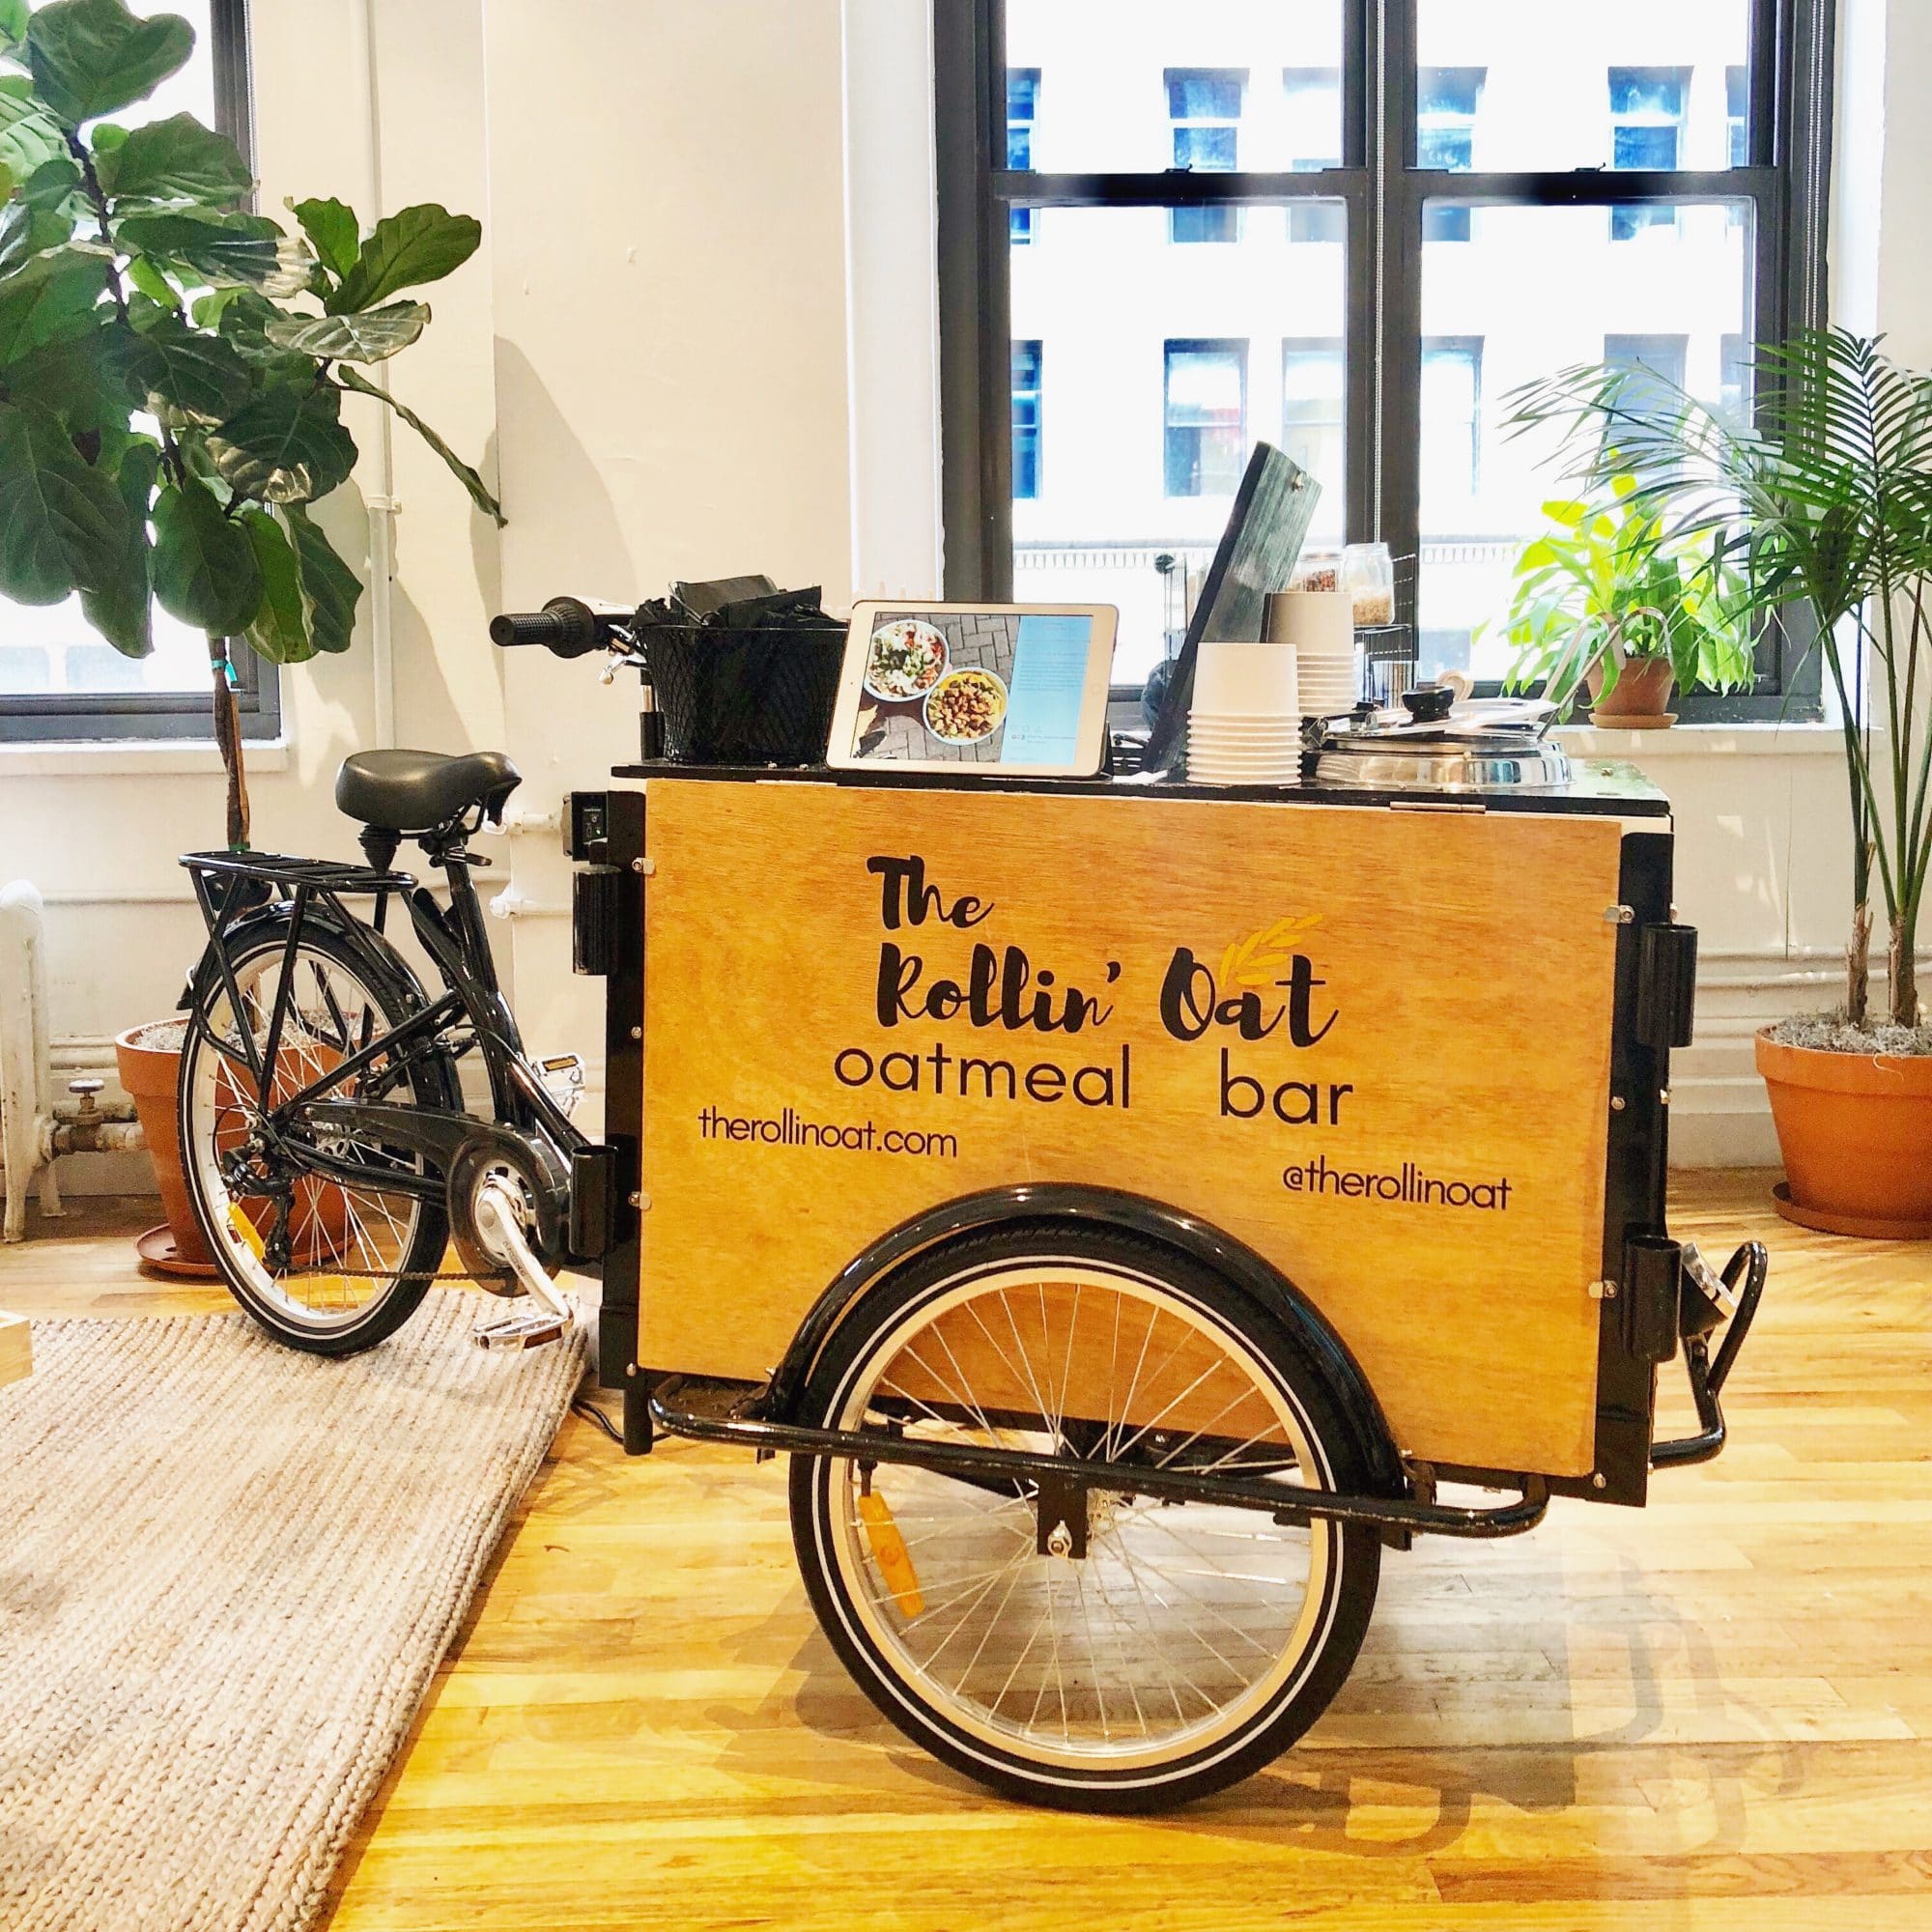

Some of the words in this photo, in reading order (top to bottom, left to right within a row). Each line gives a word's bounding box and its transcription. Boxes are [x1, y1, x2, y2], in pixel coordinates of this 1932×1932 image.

[867, 854, 995, 930] The
[875, 941, 1122, 1035] Rollin'
[1158, 946, 1339, 1049] Oat
[834, 1042, 1130, 1109] oatmeal
[1219, 1046, 1354, 1126] bar
[697, 1106, 957, 1157] therollinoat.com
[1283, 1154, 1512, 1210] @therollinoat
